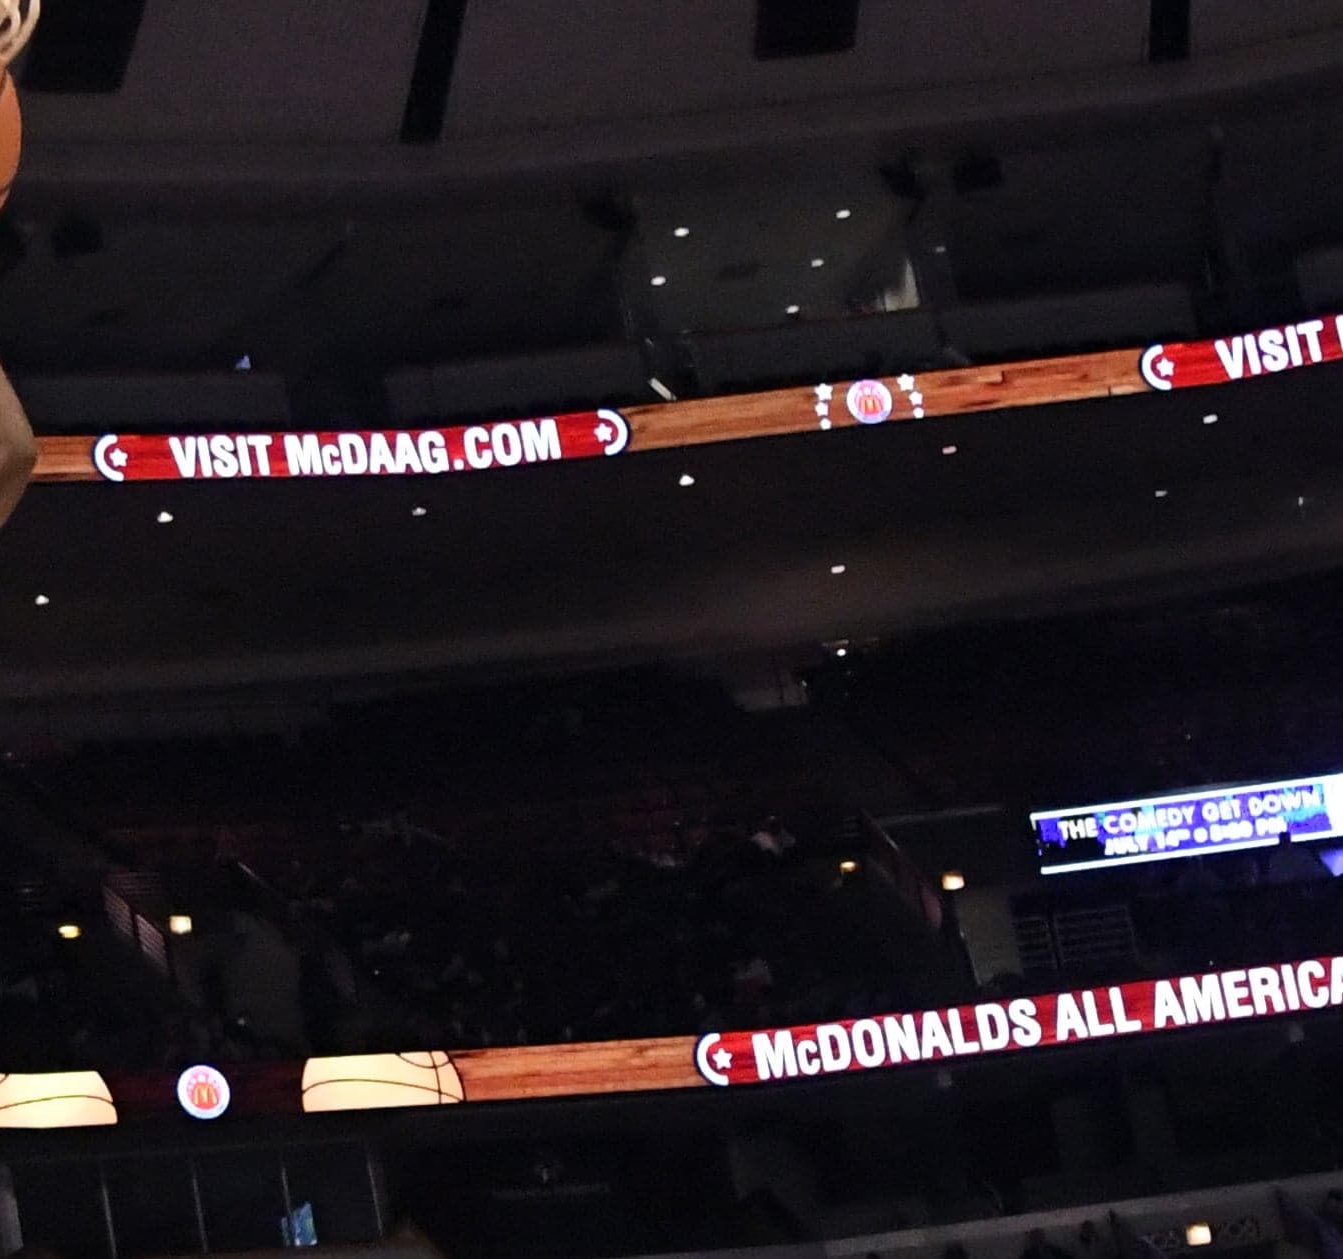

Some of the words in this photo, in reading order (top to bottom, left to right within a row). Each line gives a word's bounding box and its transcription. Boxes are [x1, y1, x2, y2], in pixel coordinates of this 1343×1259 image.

[1214, 320, 1324, 379] VISIT
[168, 435, 273, 478] VISIT
[283, 419, 562, 476] McDAAG.COM
[1058, 816, 1099, 841] THE
[1103, 805, 1196, 835] COMEDY
[1201, 797, 1242, 823] GET
[1248, 789, 1322, 817] DOWN
[753, 998, 1042, 1080] McDONALDS
[1057, 987, 1142, 1041] ALL
